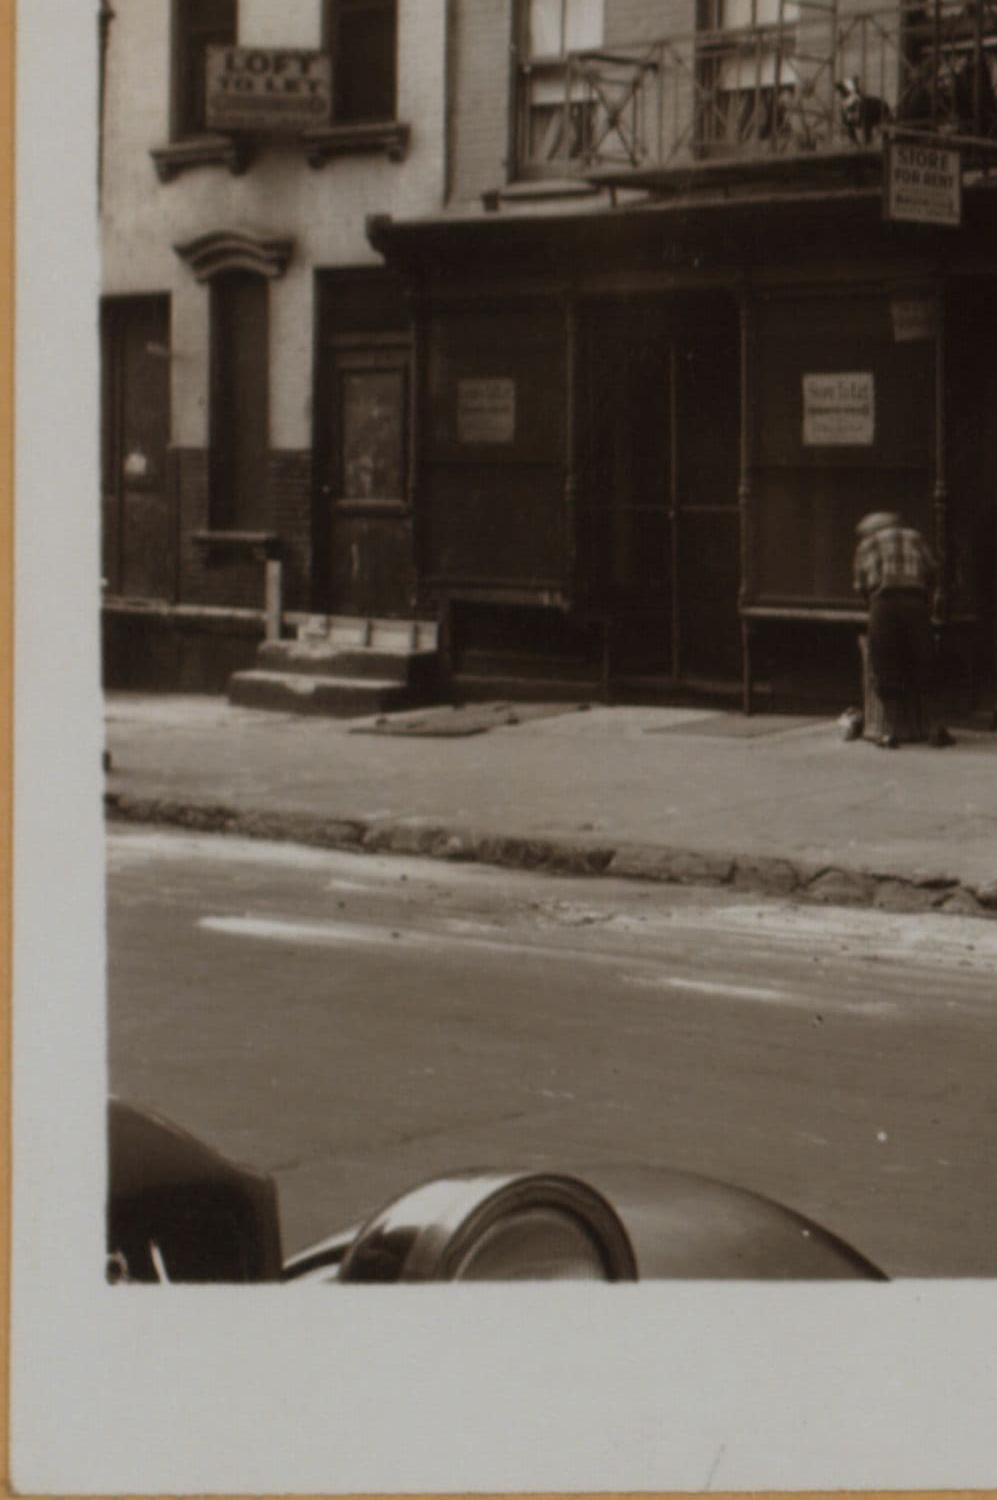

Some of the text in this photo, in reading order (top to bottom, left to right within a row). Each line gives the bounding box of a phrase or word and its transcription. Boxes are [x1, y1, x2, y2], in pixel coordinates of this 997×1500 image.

[224, 50, 316, 75] LOFT
[218, 76, 322, 93] TO LET
[897, 146, 948, 171] STORE
[894, 167, 954, 189] FOR RENT
